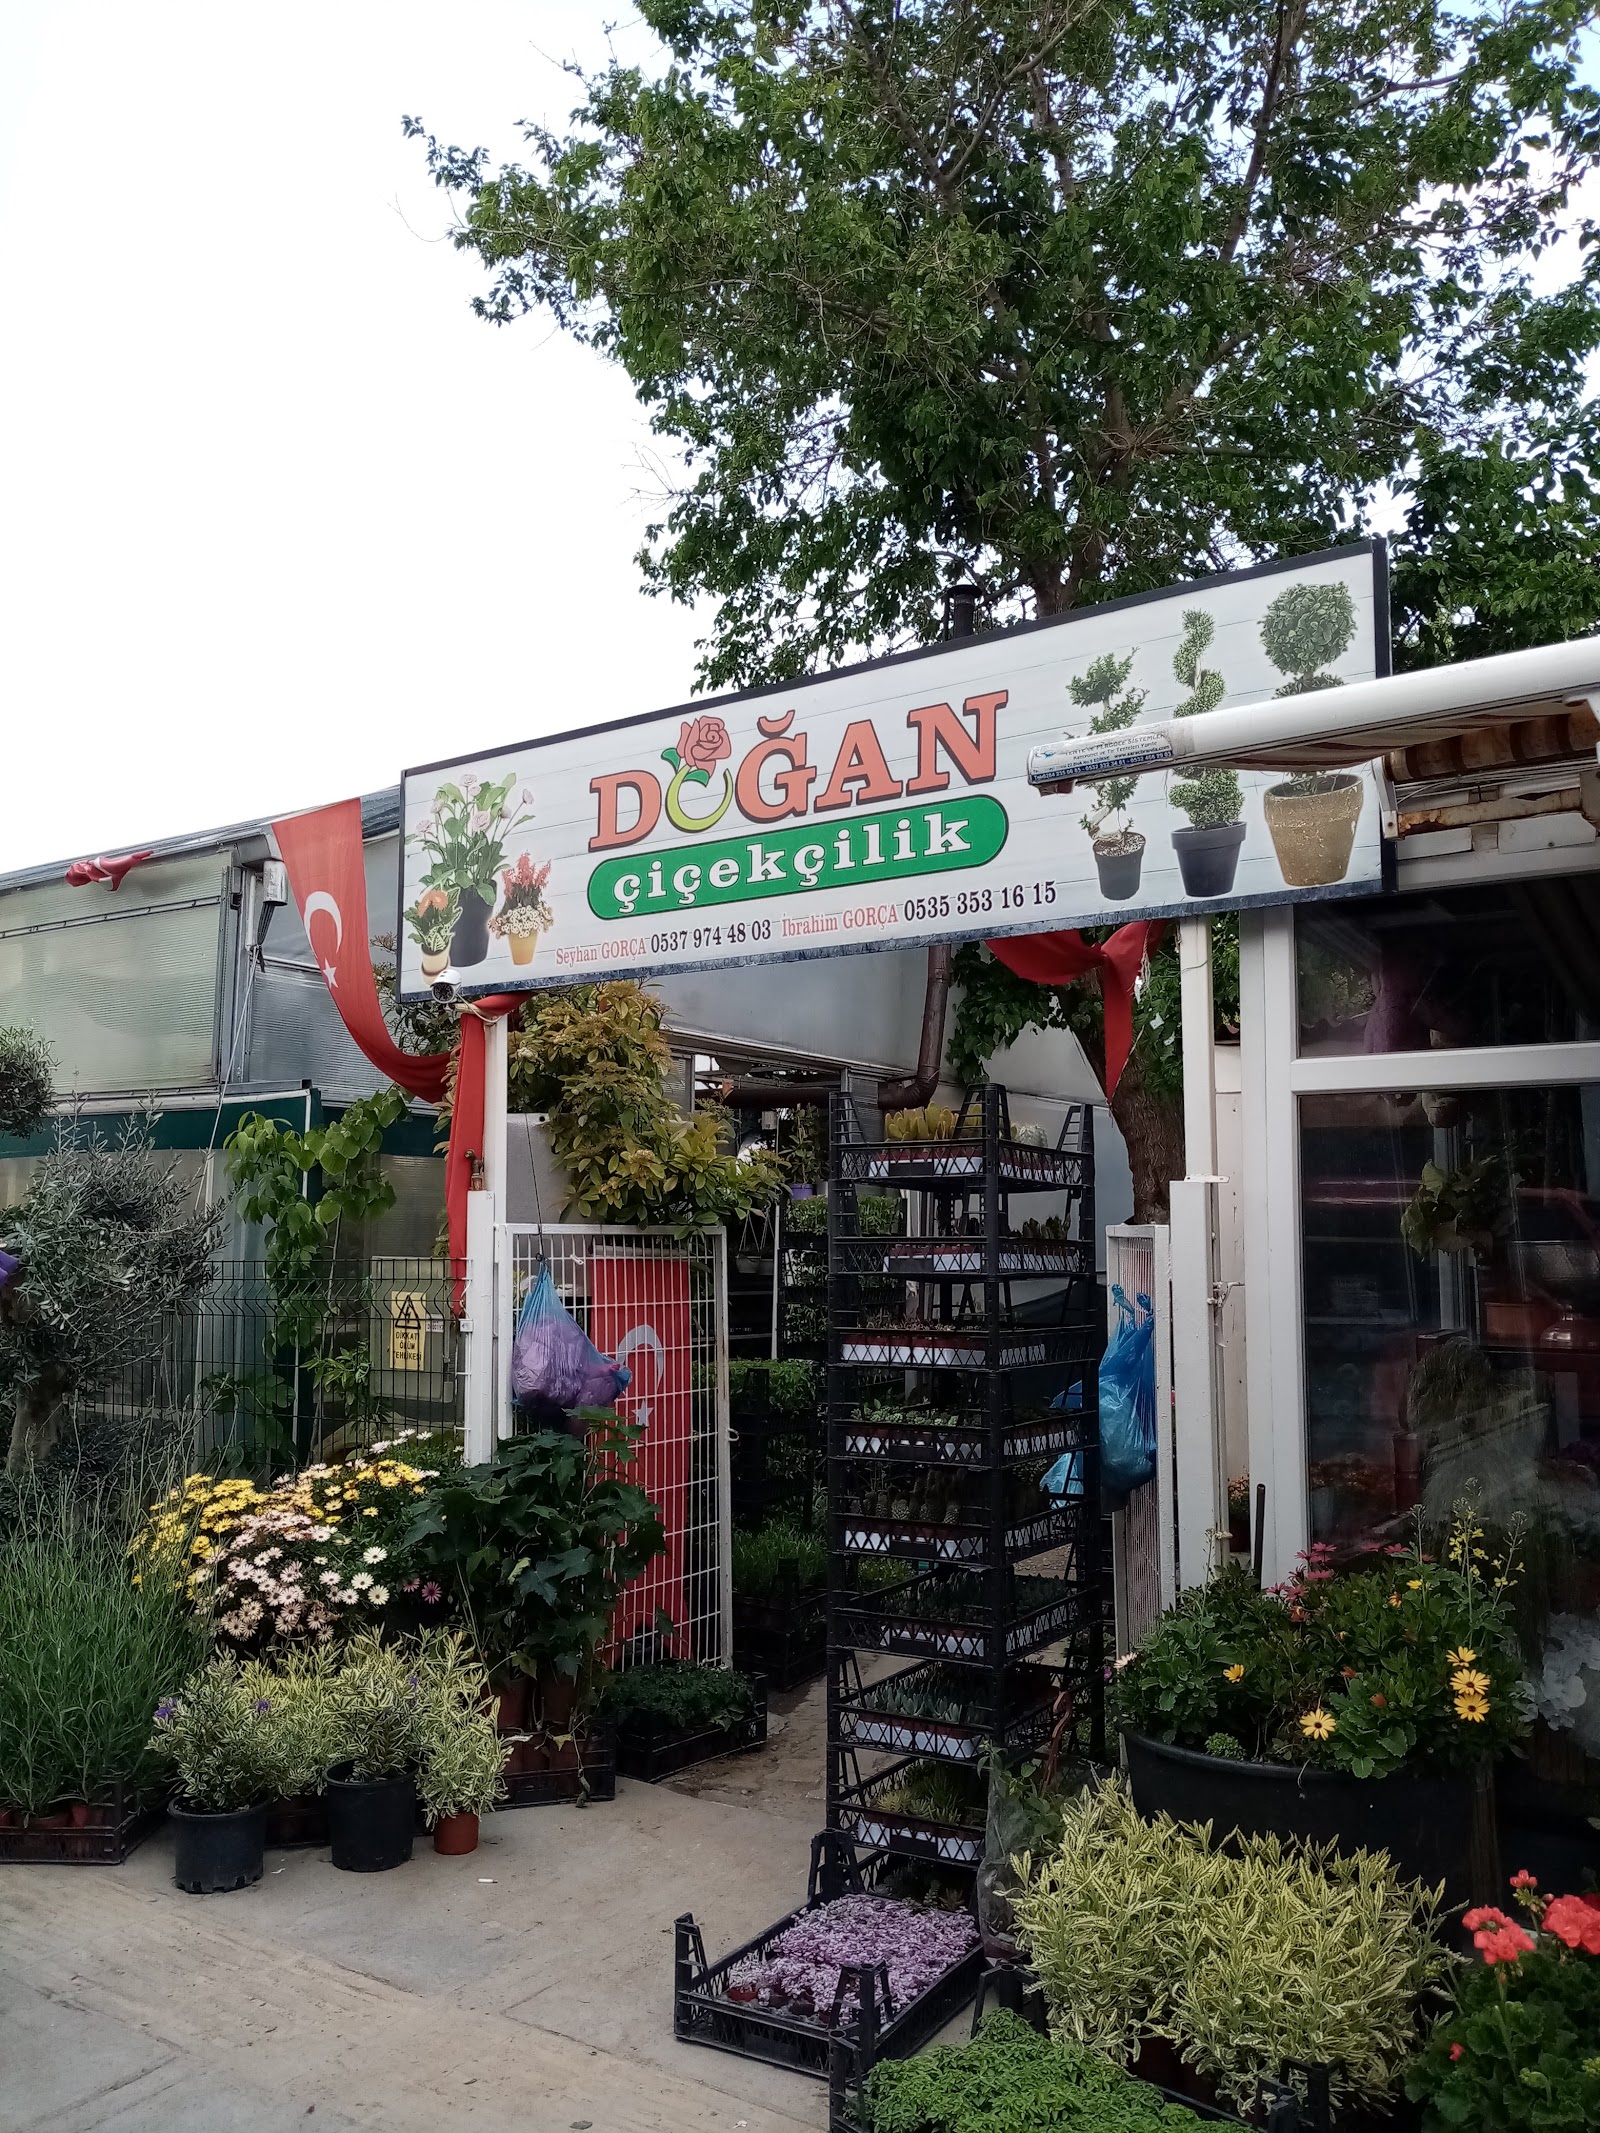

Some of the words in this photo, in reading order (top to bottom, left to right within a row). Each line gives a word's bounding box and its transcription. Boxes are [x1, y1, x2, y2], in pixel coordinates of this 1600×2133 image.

[588, 689, 1009, 853] DOĞAN
[612, 812, 973, 914] çiçekçilik
[556, 948, 597, 967] Seyhan
[601, 937, 647, 961] GORÇA
[650, 930, 687, 954] 0537
[693, 926, 722, 949] 974
[727, 922, 746, 945] 48
[751, 919, 772, 941] 03
[782, 911, 838, 937] İbrahim
[843, 904, 899, 930] GORÇA
[904, 894, 950, 922] 0535
[957, 888, 993, 915] 353
[1001, 884, 1025, 909] 16
[1033, 880, 1057, 905] 15
